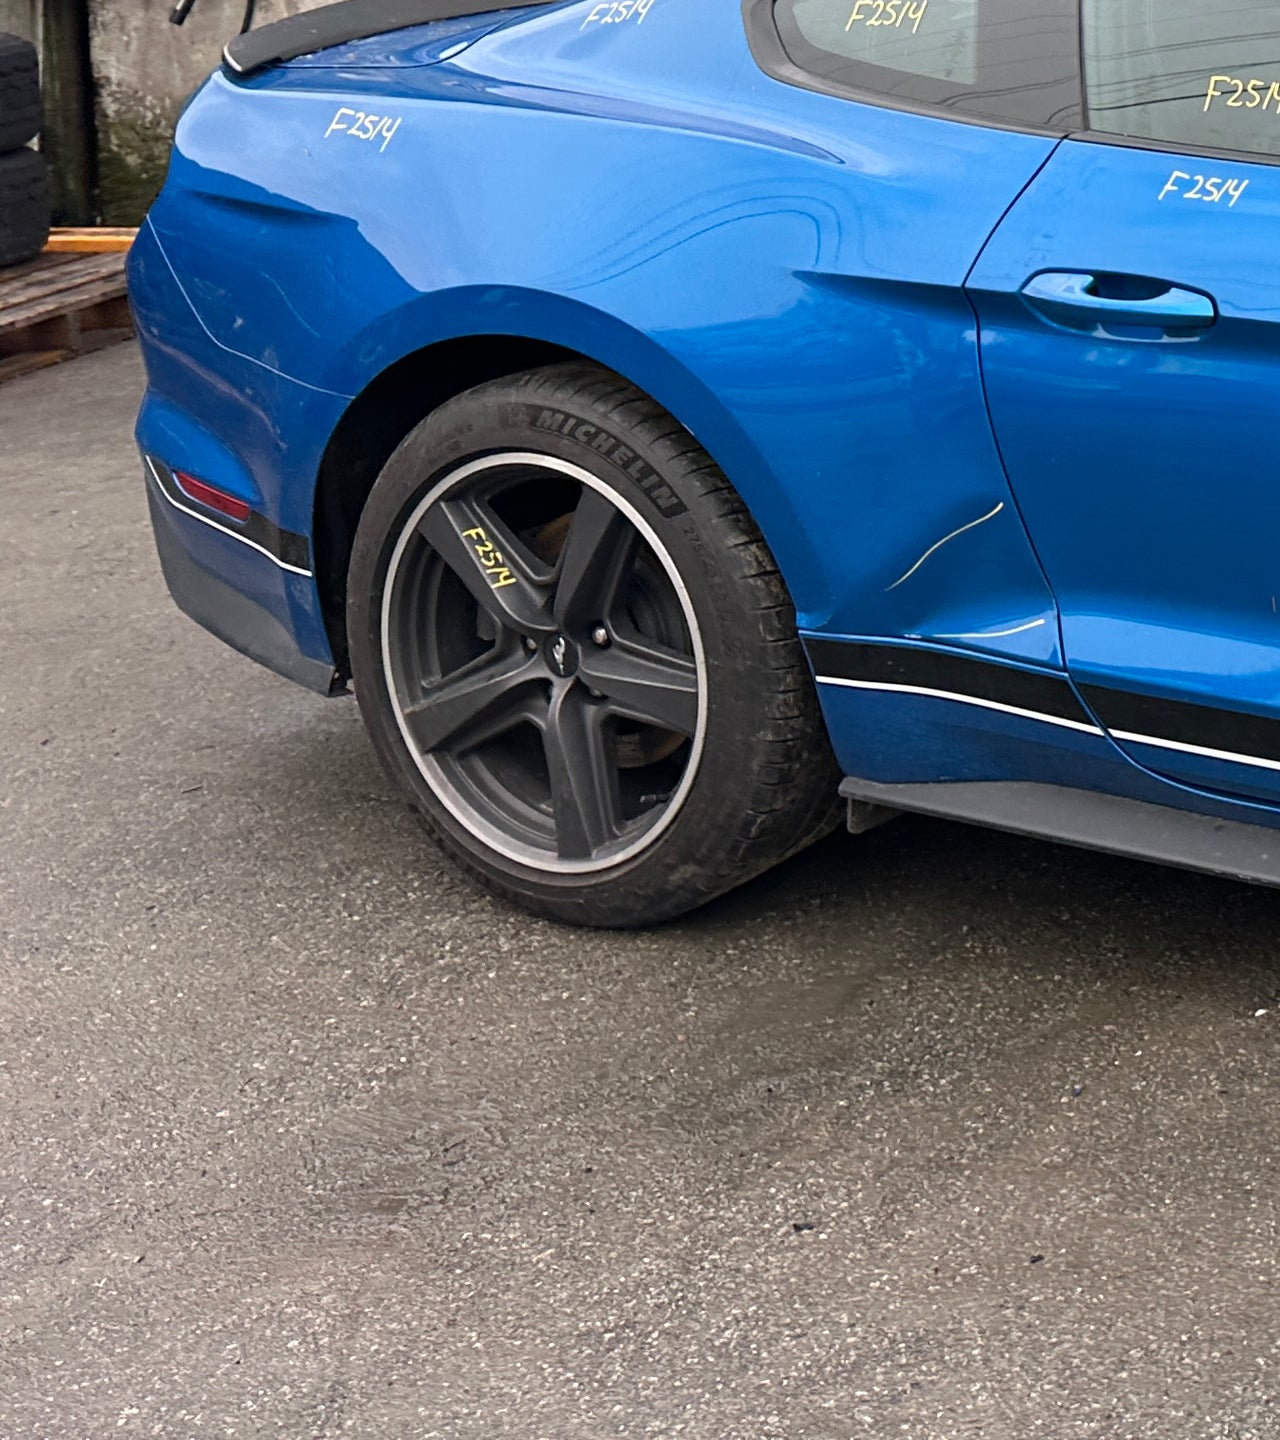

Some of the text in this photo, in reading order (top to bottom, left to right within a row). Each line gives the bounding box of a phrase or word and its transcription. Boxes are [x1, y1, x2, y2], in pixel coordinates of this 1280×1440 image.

[323, 106, 402, 154] F2514
[1157, 170, 1250, 208] F2514
[535, 409, 680, 511] MICHELIN
[459, 525, 517, 591] F2514
